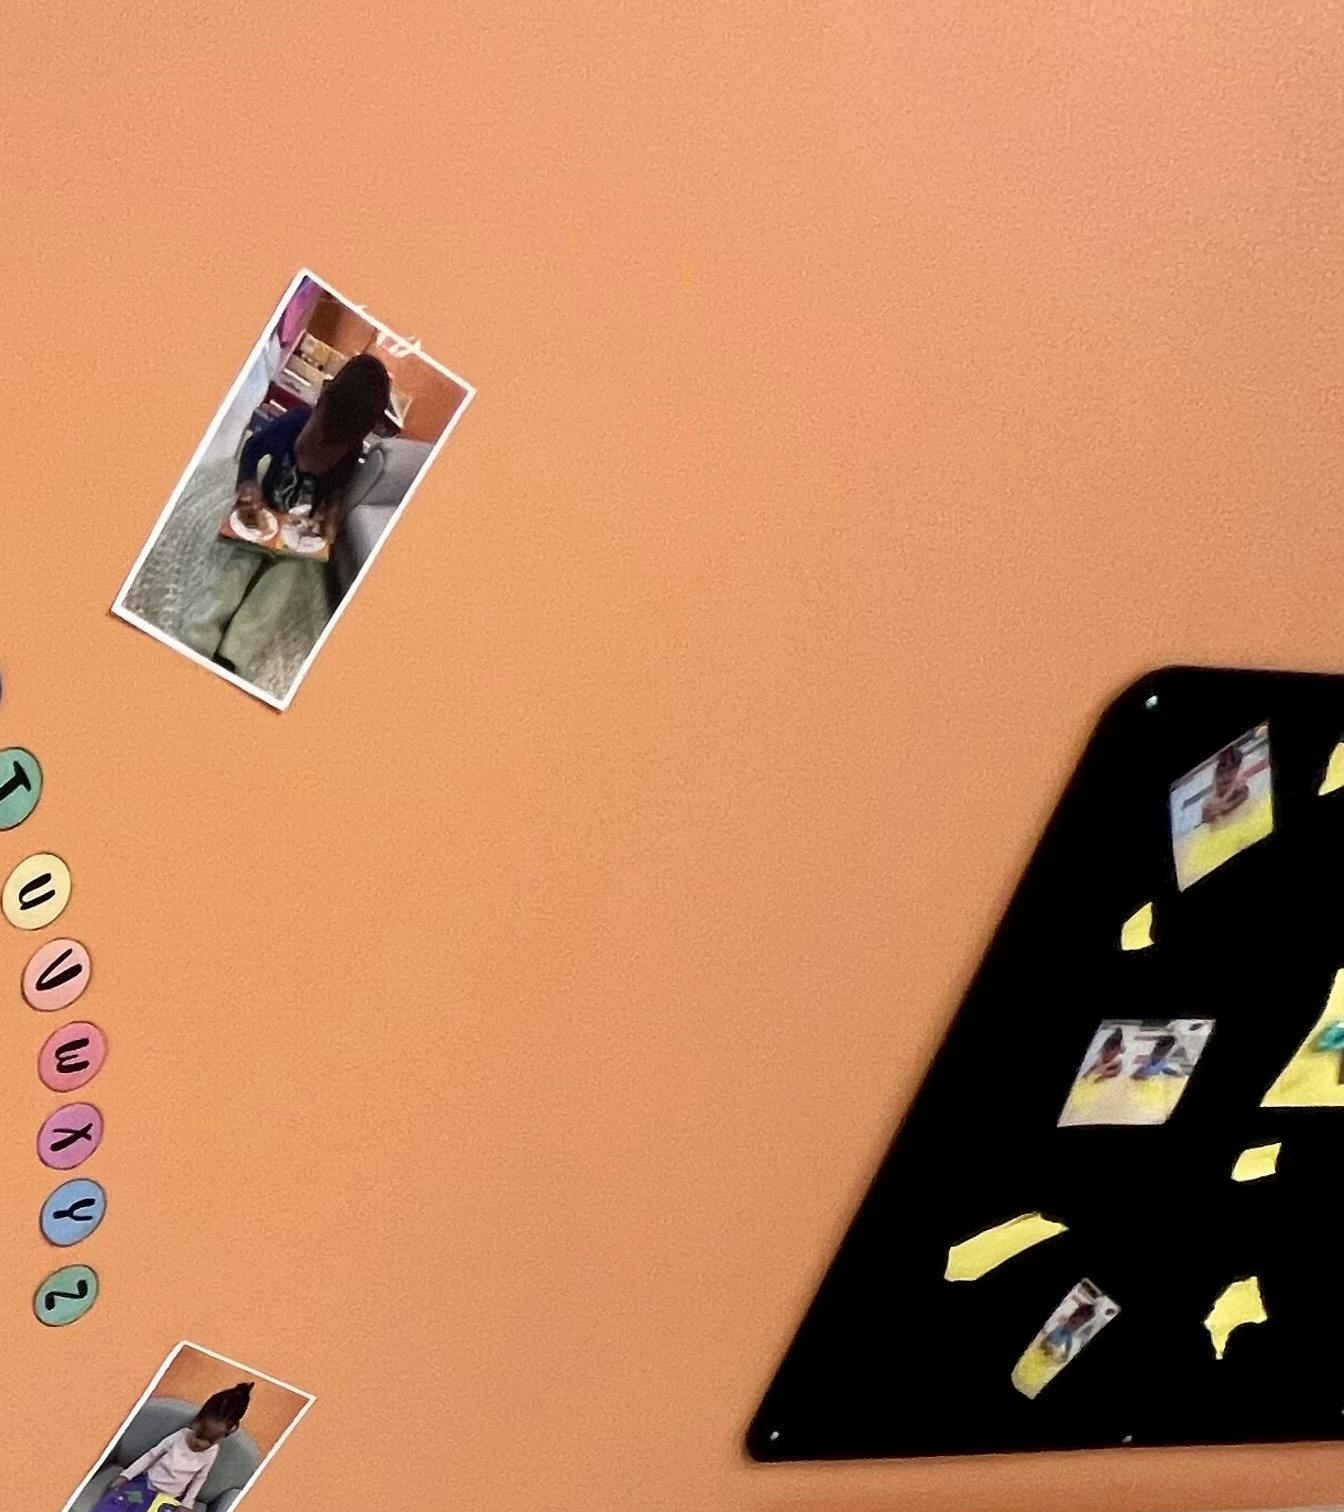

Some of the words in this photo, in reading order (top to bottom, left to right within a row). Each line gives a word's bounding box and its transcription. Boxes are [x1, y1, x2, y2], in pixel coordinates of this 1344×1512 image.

[18, 872, 56, 911] U
[35, 948, 83, 991] V
[55, 1038, 90, 1074] W
[50, 1122, 93, 1152] X
[52, 1198, 96, 1222] Y
[44, 1279, 89, 1311] Z
